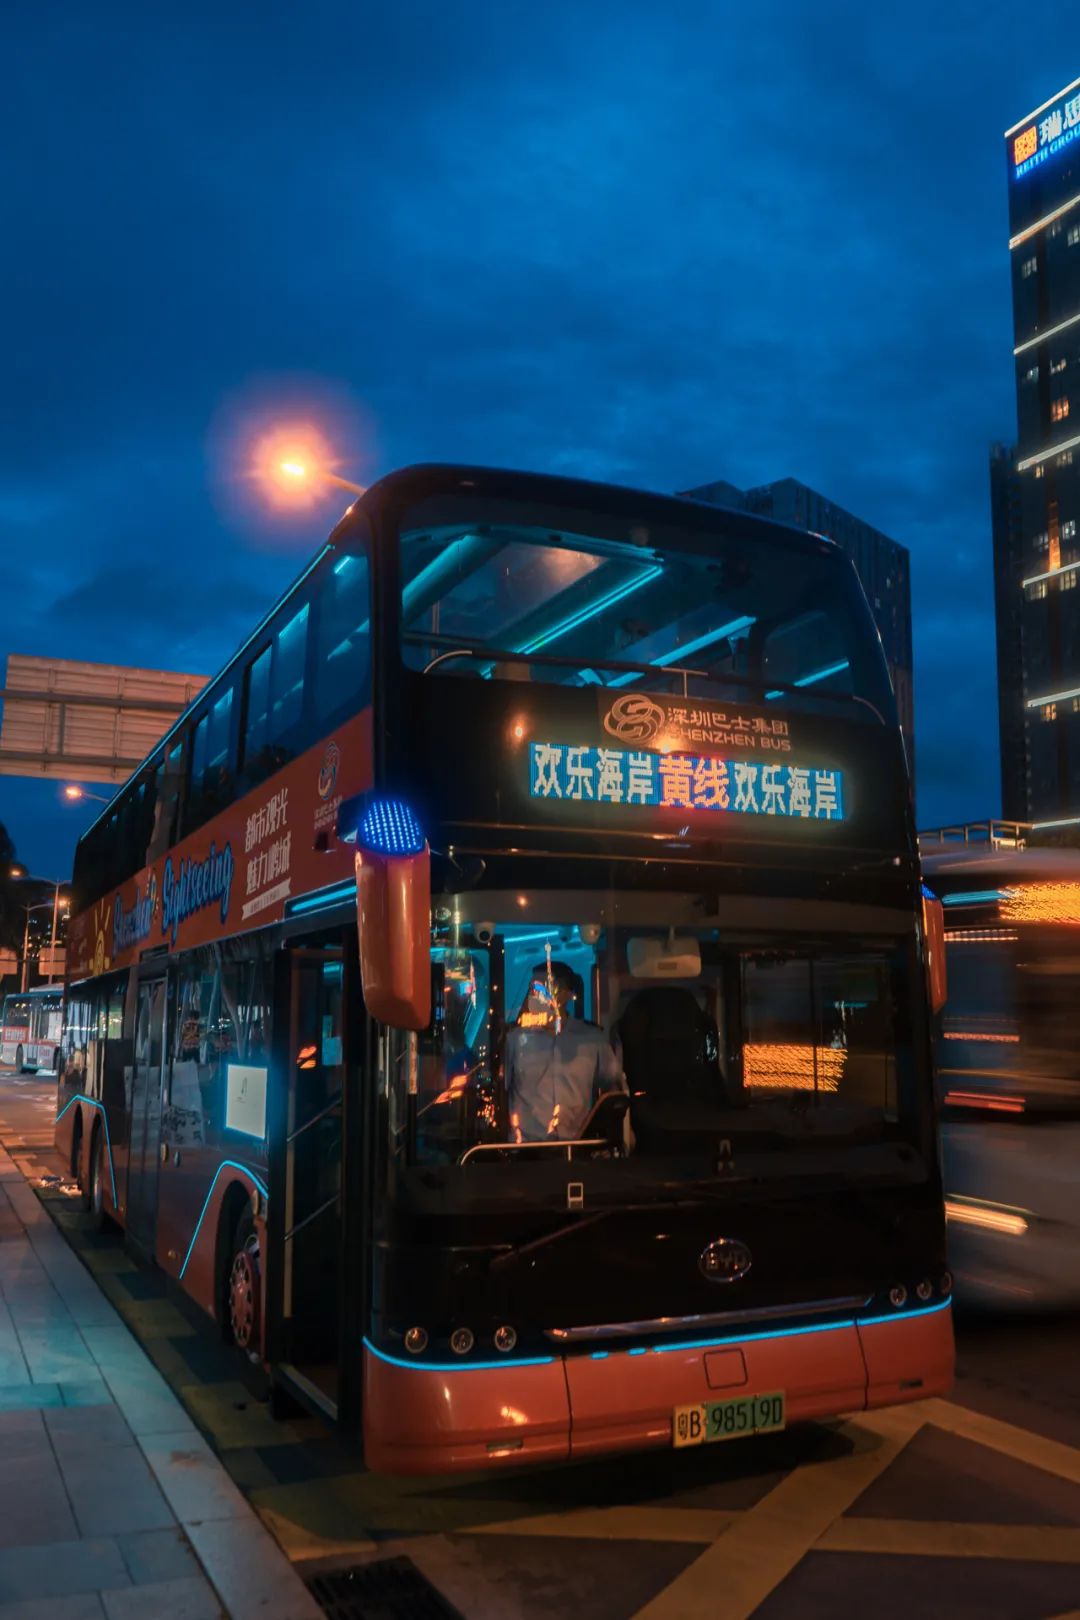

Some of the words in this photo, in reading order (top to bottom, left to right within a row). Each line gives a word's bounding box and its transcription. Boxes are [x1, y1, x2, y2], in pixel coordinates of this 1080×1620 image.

[760, 737, 792, 752] BUS
[245, 788, 288, 853] 都市观光
[162, 841, 233, 946] Sightseeing
[705, 1250, 747, 1271] BYD
